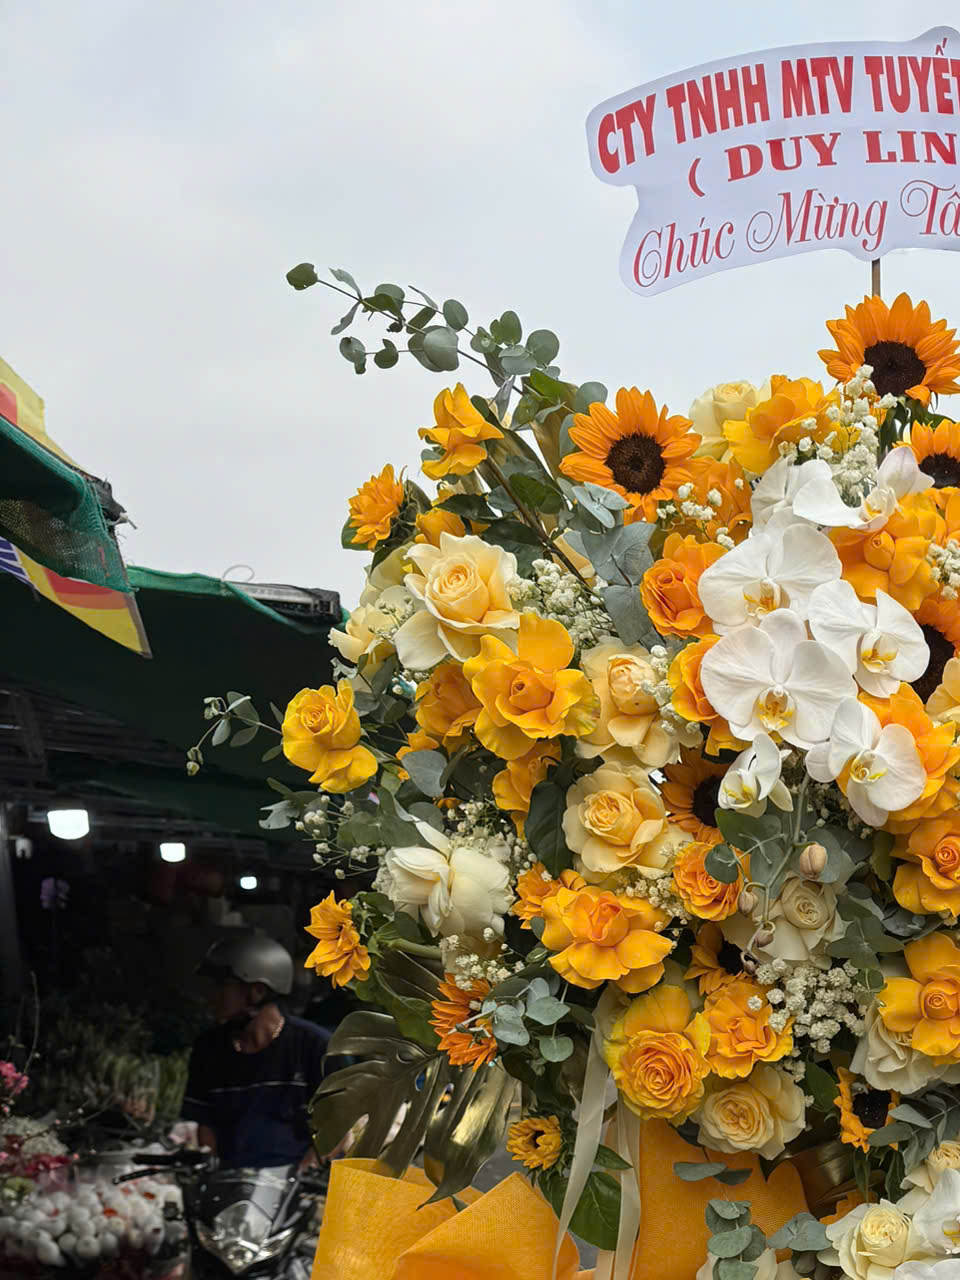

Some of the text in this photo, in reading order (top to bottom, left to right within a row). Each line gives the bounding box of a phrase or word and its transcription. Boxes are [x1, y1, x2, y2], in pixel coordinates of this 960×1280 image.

[597, 93, 657, 175] CTY
[666, 63, 770, 145] TNHH
[780, 55, 855, 120] MTV
[725, 131, 841, 183] DUY
[633, 216, 735, 287] Chúc
[746, 188, 888, 252] Mừng
